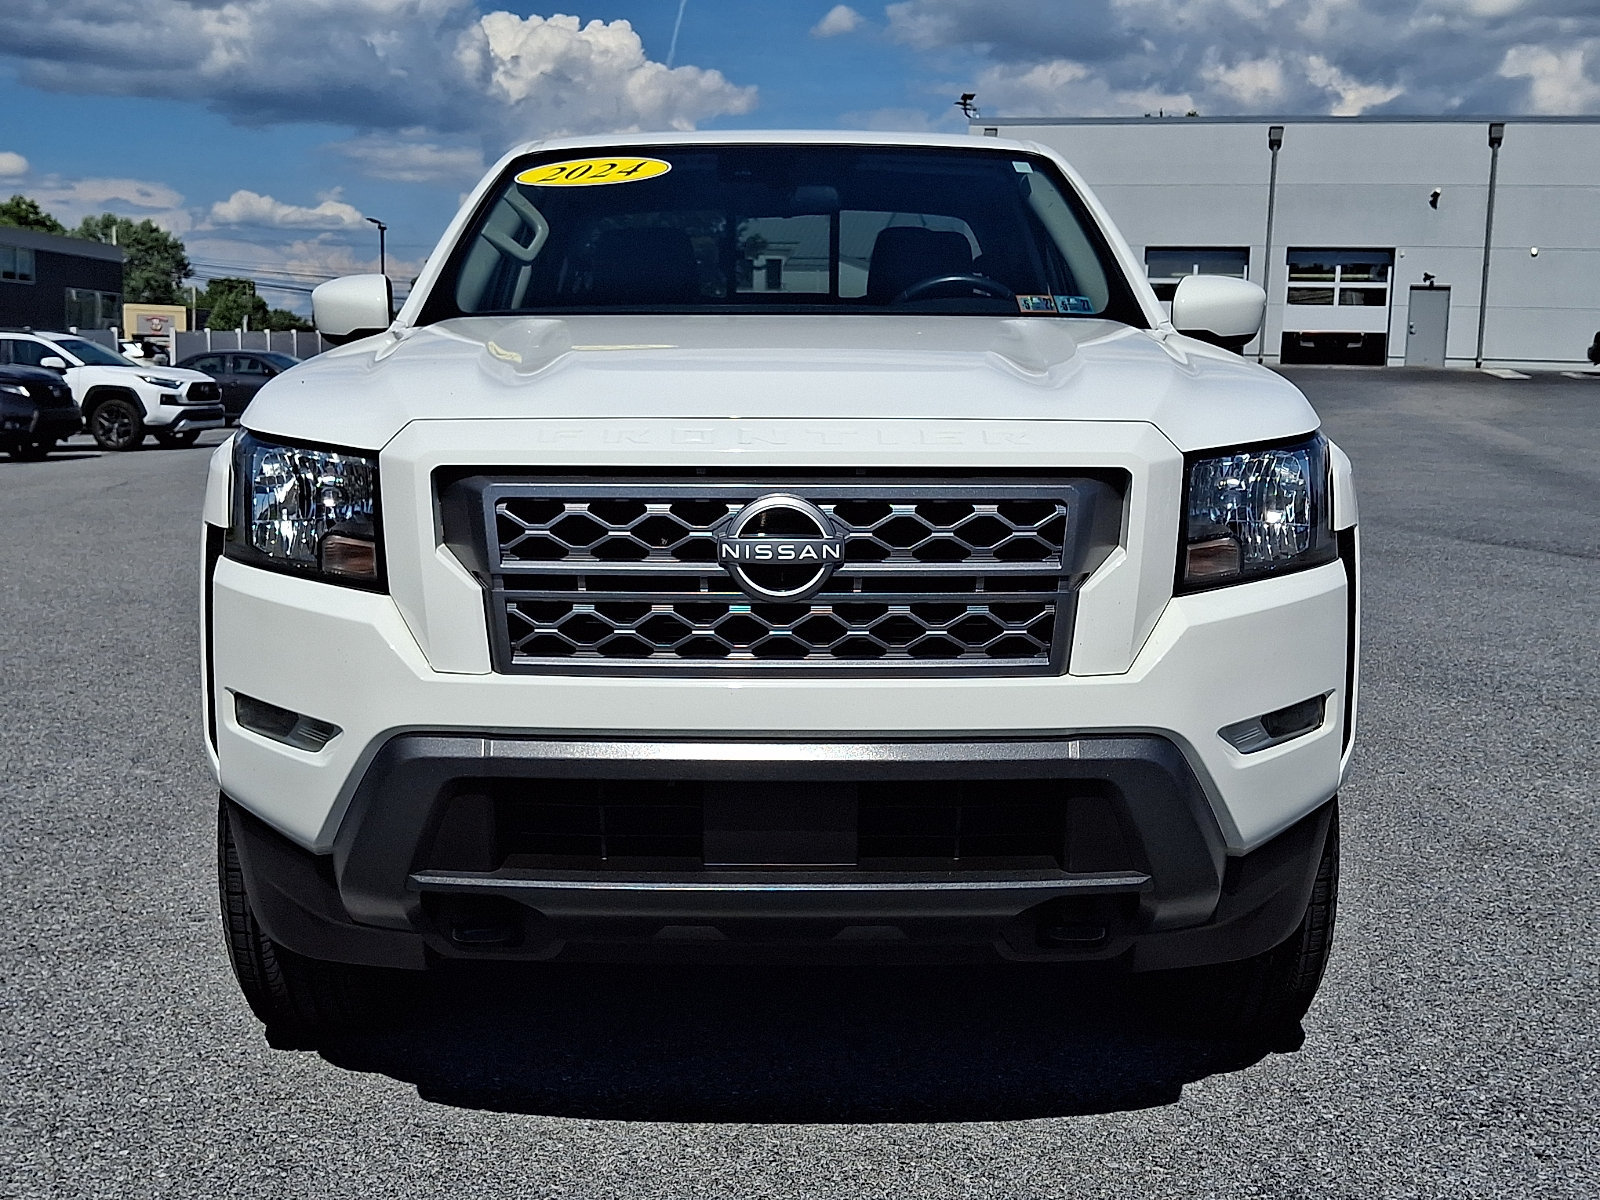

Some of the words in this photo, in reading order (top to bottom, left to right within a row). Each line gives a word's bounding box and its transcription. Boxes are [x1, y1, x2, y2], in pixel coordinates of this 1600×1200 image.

[536, 161, 648, 182] 2024
[537, 427, 1031, 446] FRONTIER
[721, 543, 840, 560] NISSAN
